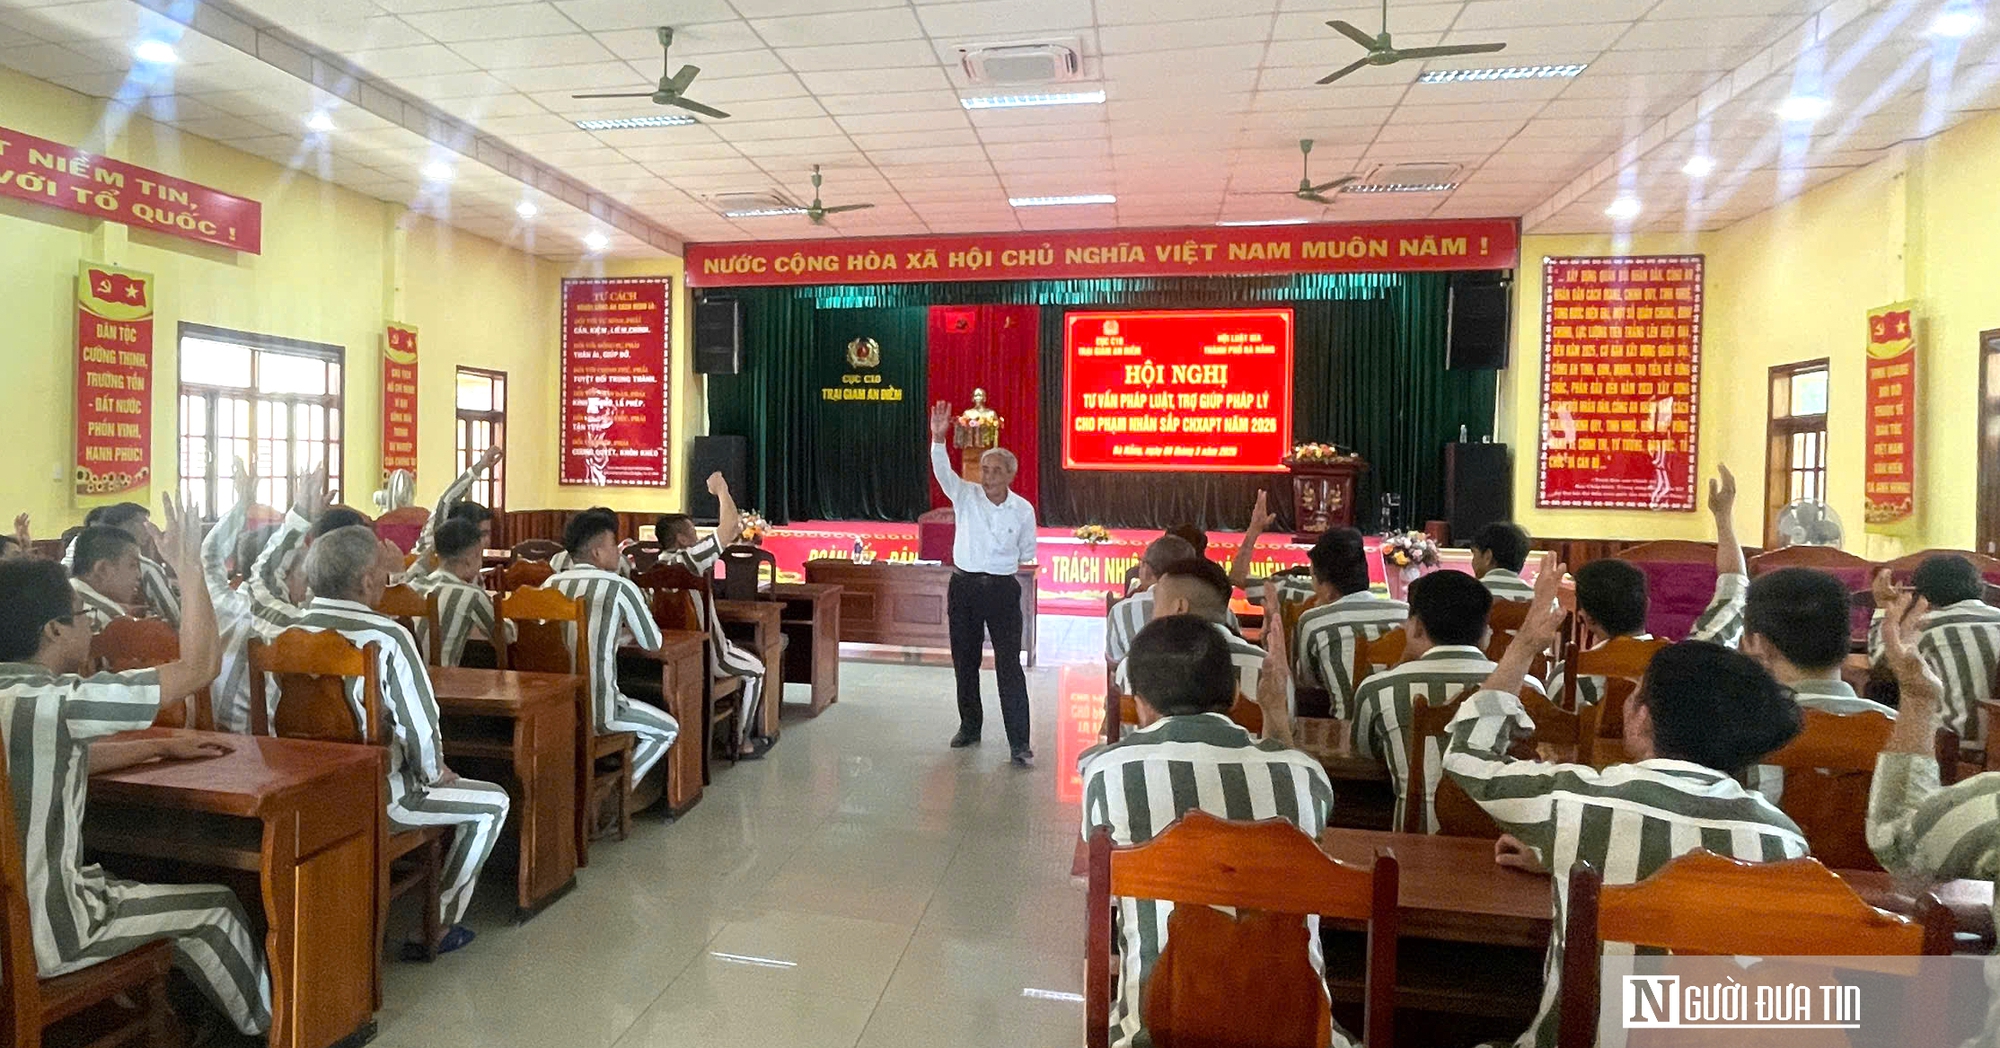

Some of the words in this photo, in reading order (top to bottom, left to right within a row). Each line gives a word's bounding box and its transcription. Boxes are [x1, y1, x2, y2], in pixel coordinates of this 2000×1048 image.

[29, 148, 124, 188] NIỀM
[135, 178, 198, 210] TIN,
[70, 186, 120, 211] TỔ
[132, 203, 217, 236] QUỐC
[704, 253, 767, 274] NƯỚC
[774, 252, 839, 275] CỘNG
[847, 250, 897, 271] HÒA
[905, 249, 938, 269] XÃ
[948, 246, 992, 270] HỘI
[1001, 243, 1054, 266] CHỦ
[1065, 242, 1145, 265] NGHĨA
[1155, 240, 1218, 265] VIỆT
[1228, 242, 1291, 260] NAM
[1302, 236, 1388, 259] MUÔN
[1399, 235, 1467, 256] NĂM
[1480, 237, 1488, 255] !
[119, 325, 137, 344] TỘC
[1124, 359, 1165, 389] HỘI
[1171, 364, 1228, 389] NGHỊ
[867, 388, 879, 400] AN
[1083, 393, 1097, 409] TƯ
[1097, 388, 1118, 409] VẤN
[1120, 391, 1147, 409] PHÁP
[1149, 390, 1175, 412] LUẬT,
[1178, 392, 1198, 412] TRỢ
[1199, 390, 1224, 409] GIÚP
[1226, 390, 1254, 409] PHÁP
[1256, 389, 1269, 409] LÝ
[1075, 417, 1095, 432] CHO
[1097, 417, 1127, 435] PHẠM
[1129, 414, 1157, 432] NHÂN
[1159, 412, 1180, 432] SẮP
[1182, 417, 1222, 432] CHXAPT
[1224, 414, 1249, 432] NĂM
[1052, 550, 1100, 583] TRÁCH
